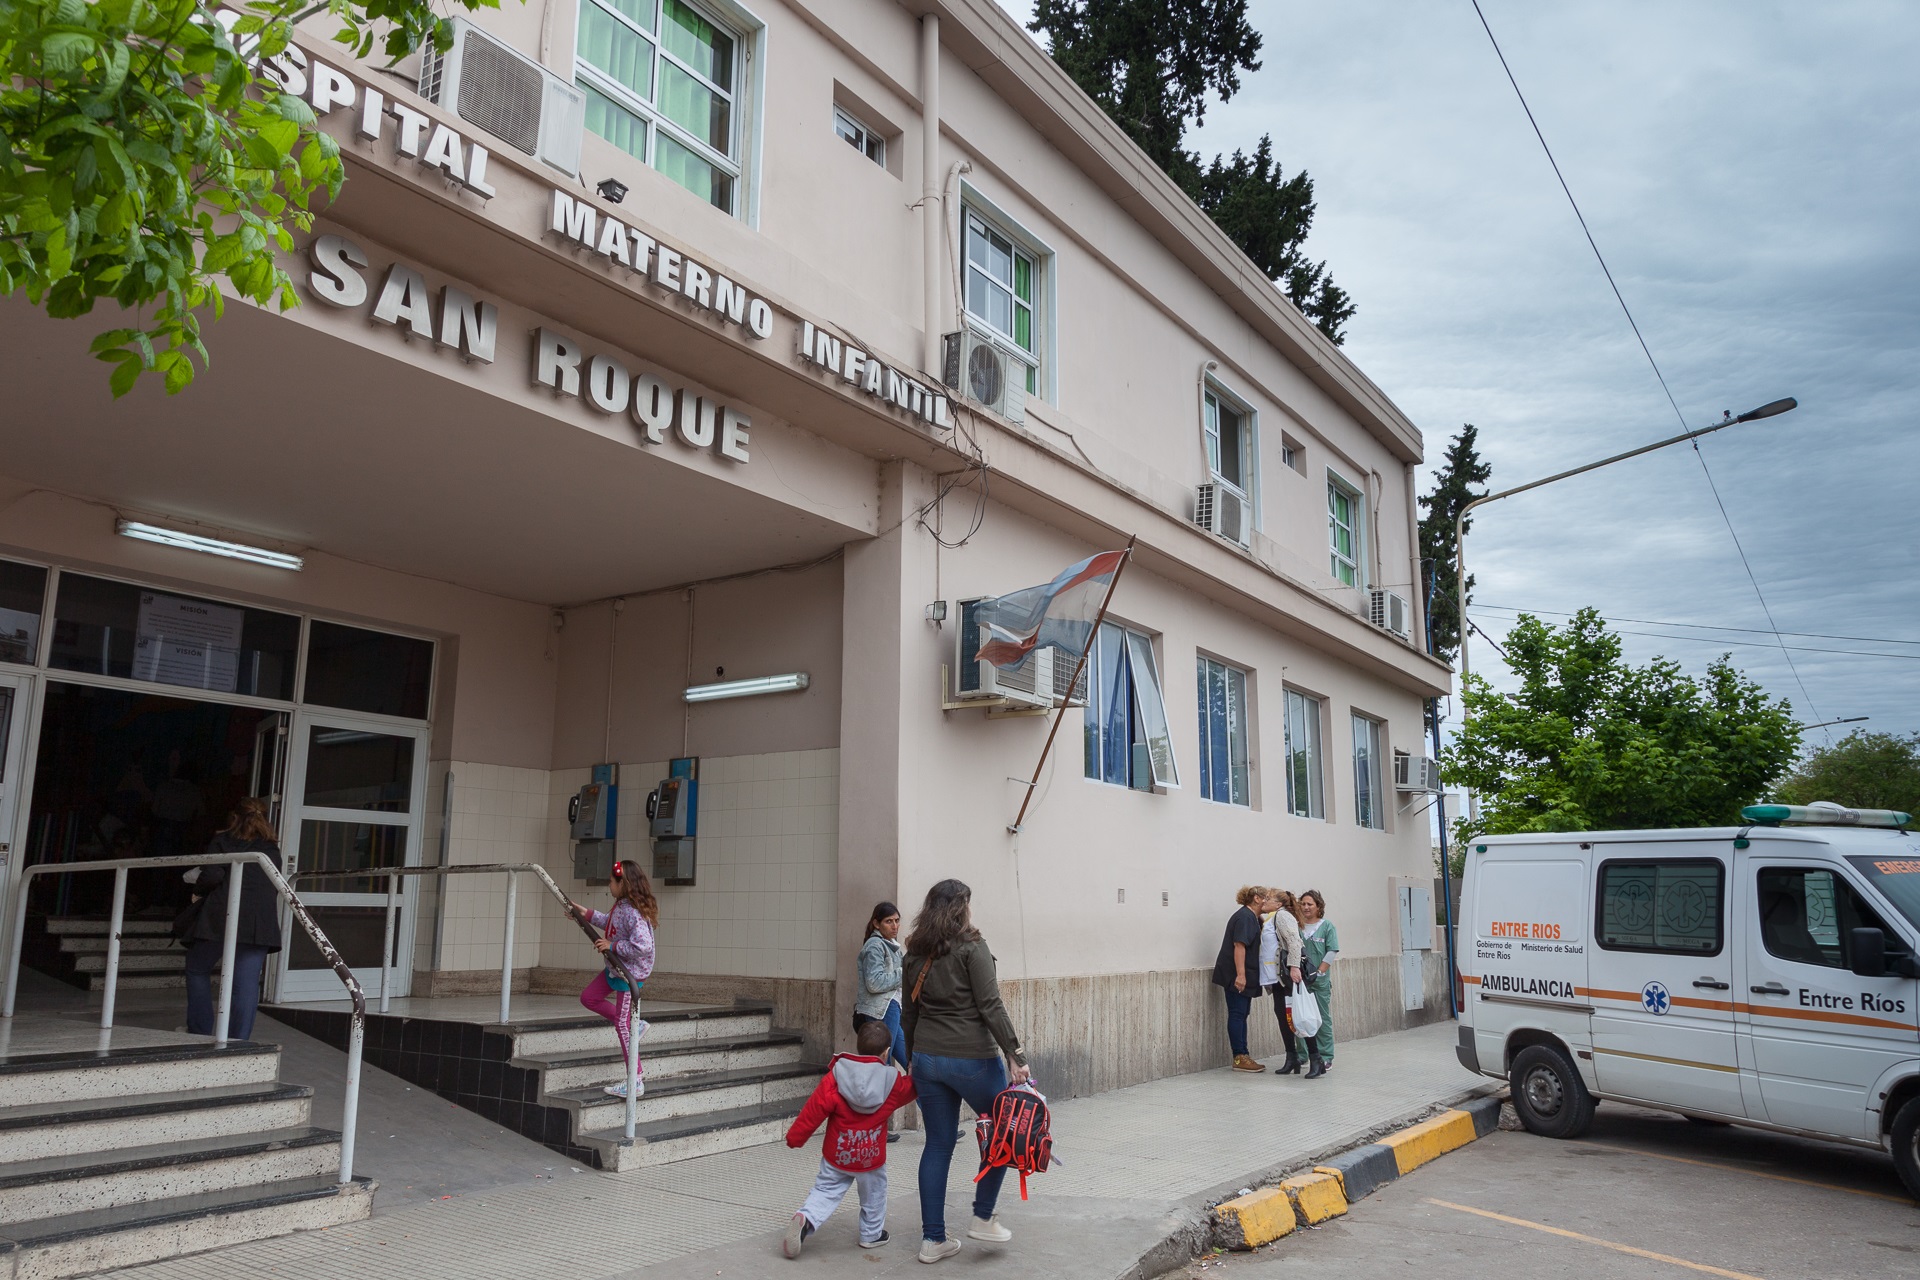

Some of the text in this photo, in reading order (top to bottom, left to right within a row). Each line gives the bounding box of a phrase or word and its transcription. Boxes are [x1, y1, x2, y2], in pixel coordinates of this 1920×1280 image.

[188, 0, 952, 430] SPITAL MATERNO INFANTIL
[307, 234, 751, 464] SAN ROQUE
[180, 605, 208, 615] MISIÓN
[176, 647, 203, 657] VISIÓN
[1491, 921, 1561, 939] ENTRE RIOS
[1476, 940, 1503, 949] Gobierno
[1521, 943, 1583, 954] Ministerio de Salud
[1477, 950, 1495, 959] Entre
[1481, 974, 1575, 999] AMBULANCIA
[1799, 988, 1905, 1013] Entre Ríos
